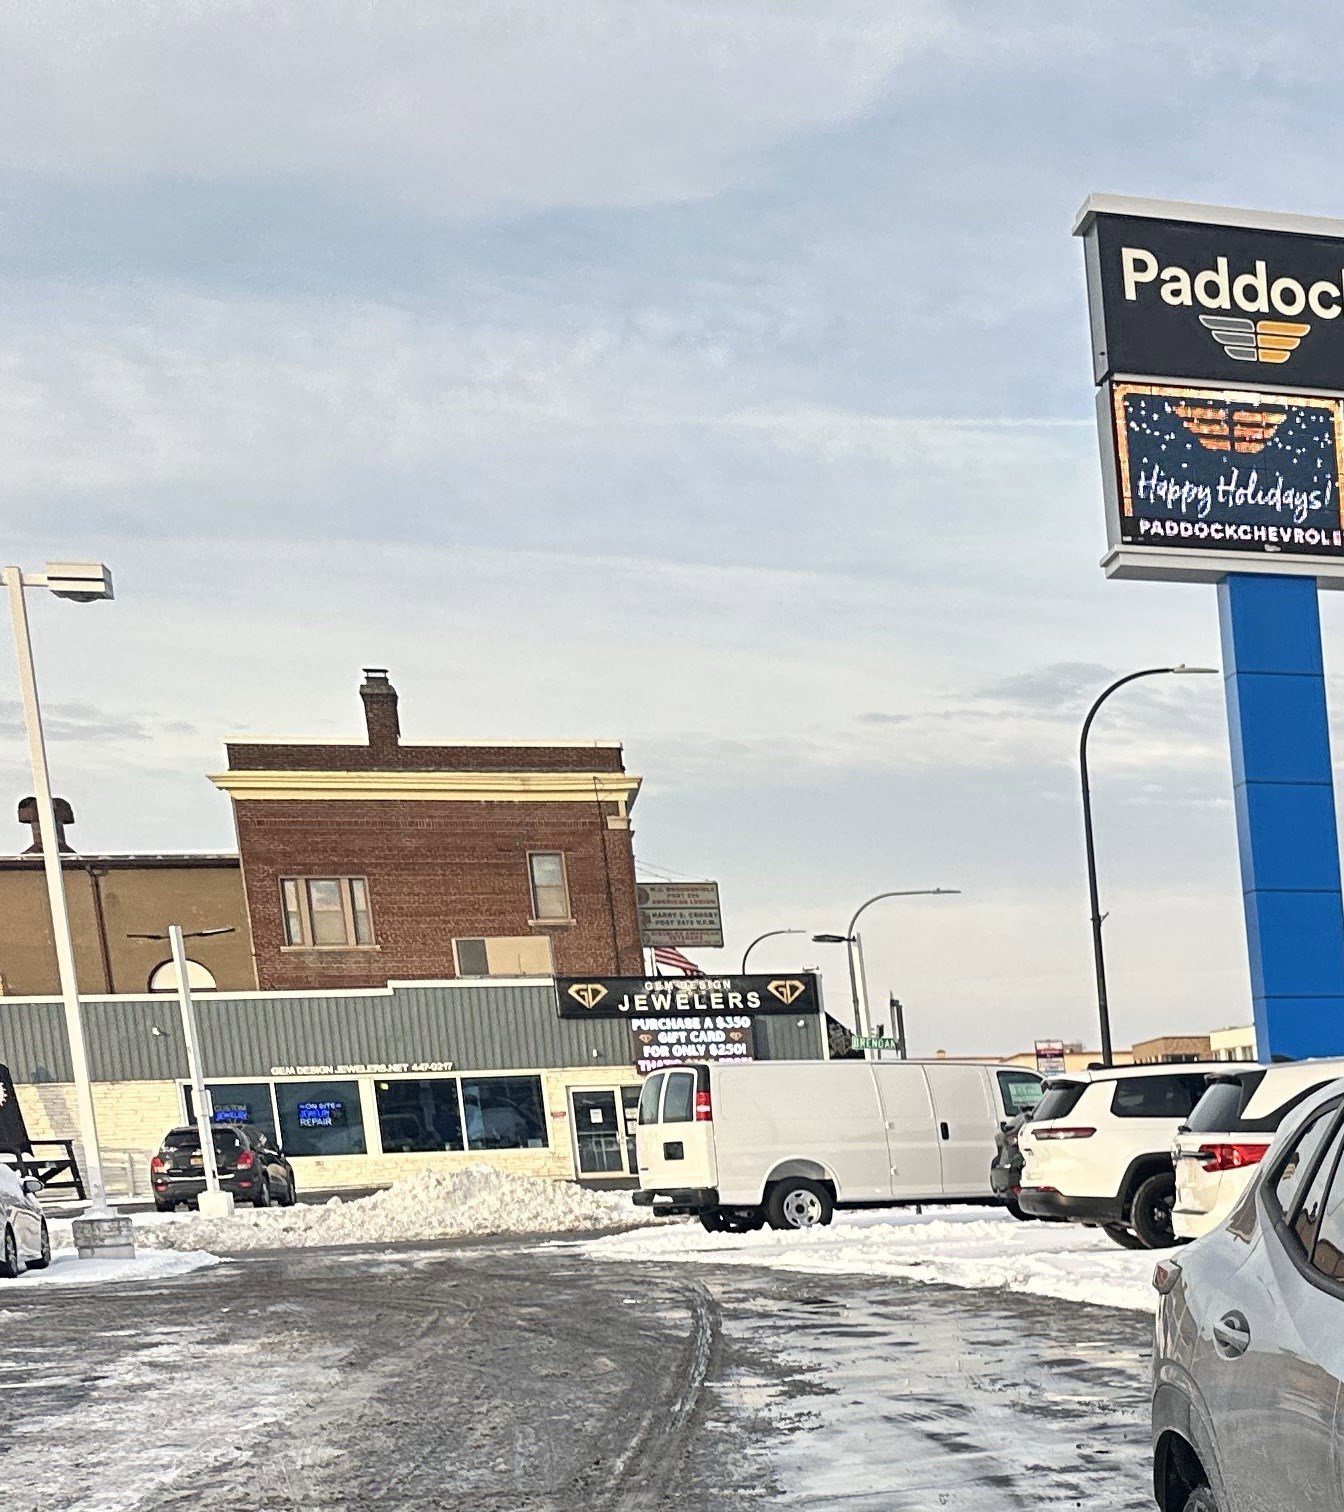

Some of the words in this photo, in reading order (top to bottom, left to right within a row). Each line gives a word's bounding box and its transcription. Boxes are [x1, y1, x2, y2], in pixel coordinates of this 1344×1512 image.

[1138, 464, 1211, 518] Happy
[1217, 467, 1331, 523] Holidays!
[618, 992, 761, 1011] JEWELERS
[632, 1017, 701, 1031] PURCHASE
[704, 1017, 713, 1029] A
[658, 1031, 687, 1043] GIFT
[690, 1030, 726, 1042] CARD
[643, 1045, 669, 1057] FOR
[672, 1043, 706, 1057] ONLY
[300, 1117, 332, 1126] REPAIR
